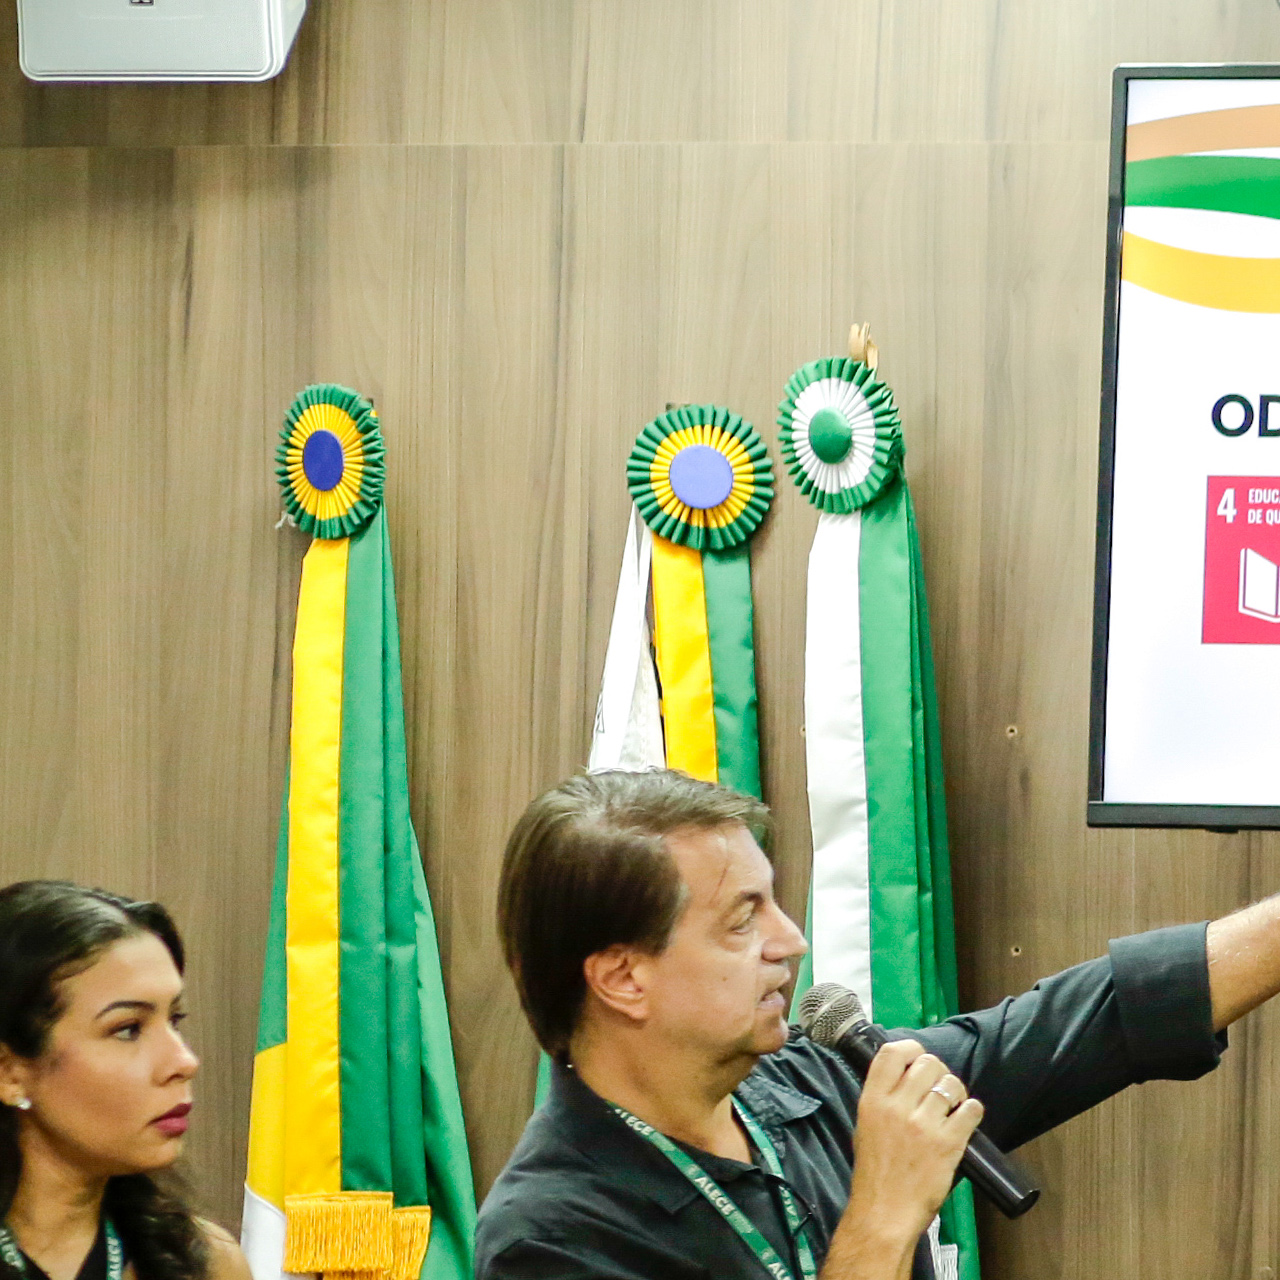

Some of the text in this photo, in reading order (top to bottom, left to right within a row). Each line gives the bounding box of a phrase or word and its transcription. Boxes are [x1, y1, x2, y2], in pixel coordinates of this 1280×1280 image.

[1217, 488, 1237, 523] 4
[1248, 509, 1262, 524] DE
[694, 1176, 736, 1216] ALECE
